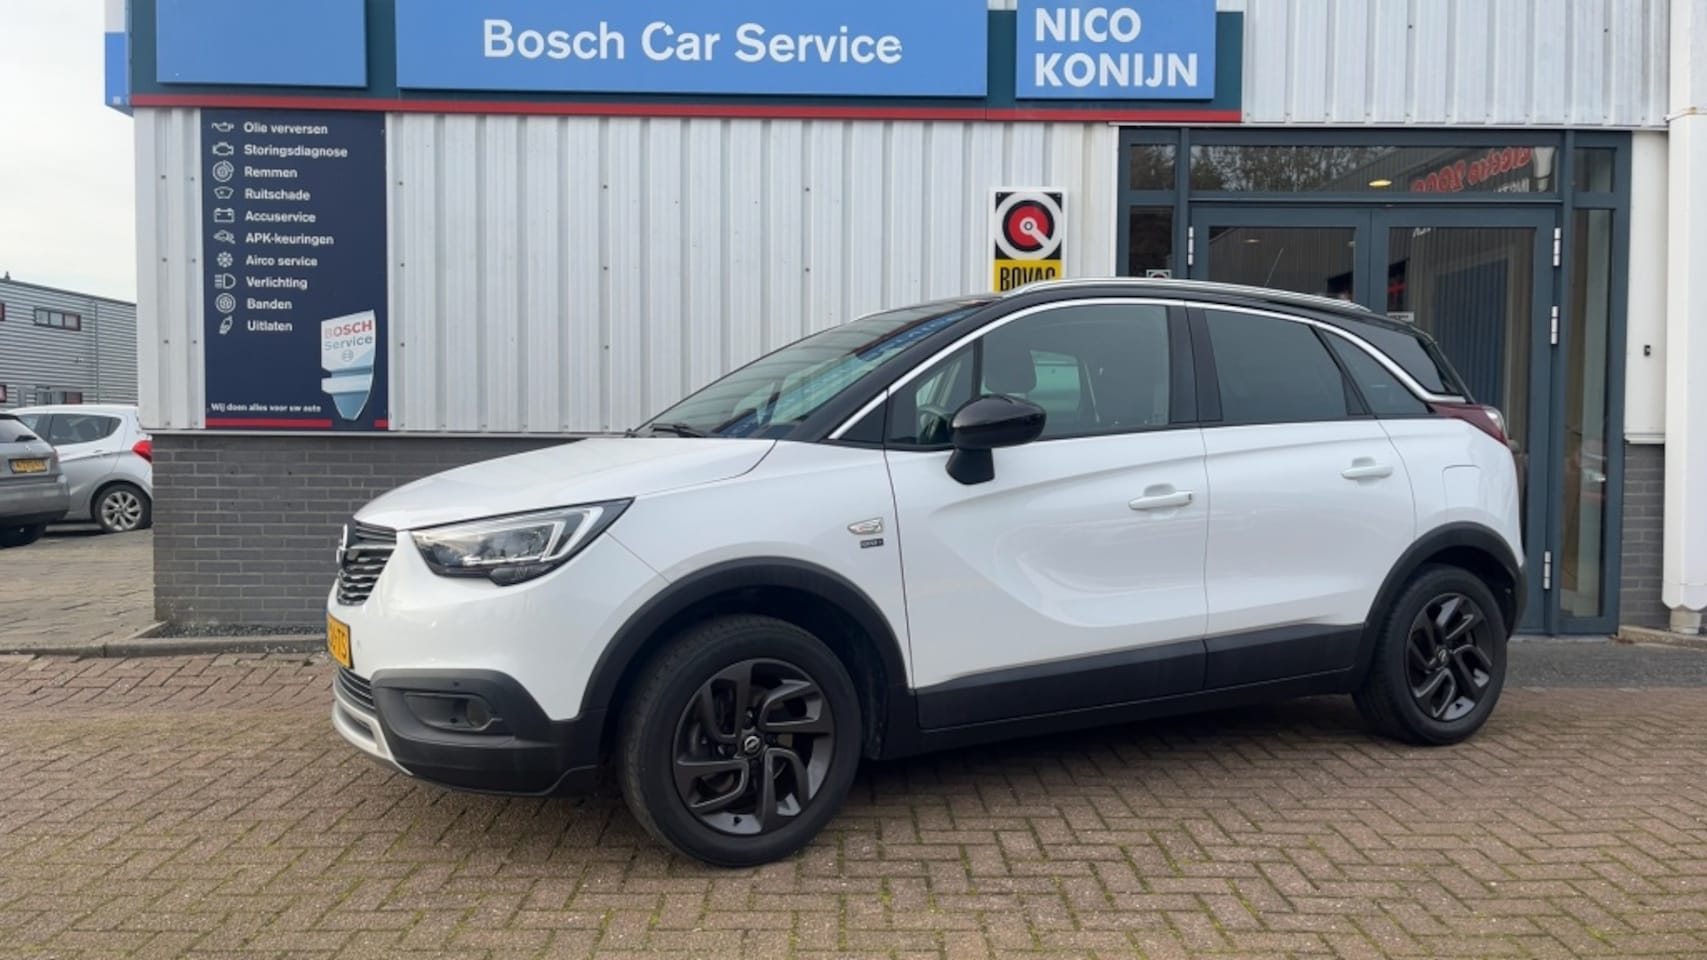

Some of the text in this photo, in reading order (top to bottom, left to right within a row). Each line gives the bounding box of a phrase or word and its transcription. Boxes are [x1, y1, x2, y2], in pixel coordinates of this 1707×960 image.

[1035, 7, 1142, 43] NICO
[483, 18, 903, 64] Bosch Car Service
[1035, 52, 1198, 88] KONIJN
[243, 121, 328, 135] Olie verversen
[244, 144, 348, 159] Storingsdiagnose
[244, 166, 298, 178] Remmen
[244, 188, 311, 201] Ruitschade
[245, 210, 316, 223] Accuservice
[245, 232, 334, 247] APK-keuringen
[245, 255, 318, 267] Airco service
[245, 276, 308, 291] Verlichting
[247, 298, 293, 310] Banden
[247, 320, 293, 332] Uitlaten
[324, 319, 373, 339] BOSCH
[324, 335, 373, 351] Service
[210, 402, 226, 413] Wij
[226, 403, 248, 411] doen
[249, 403, 268, 411] alles
